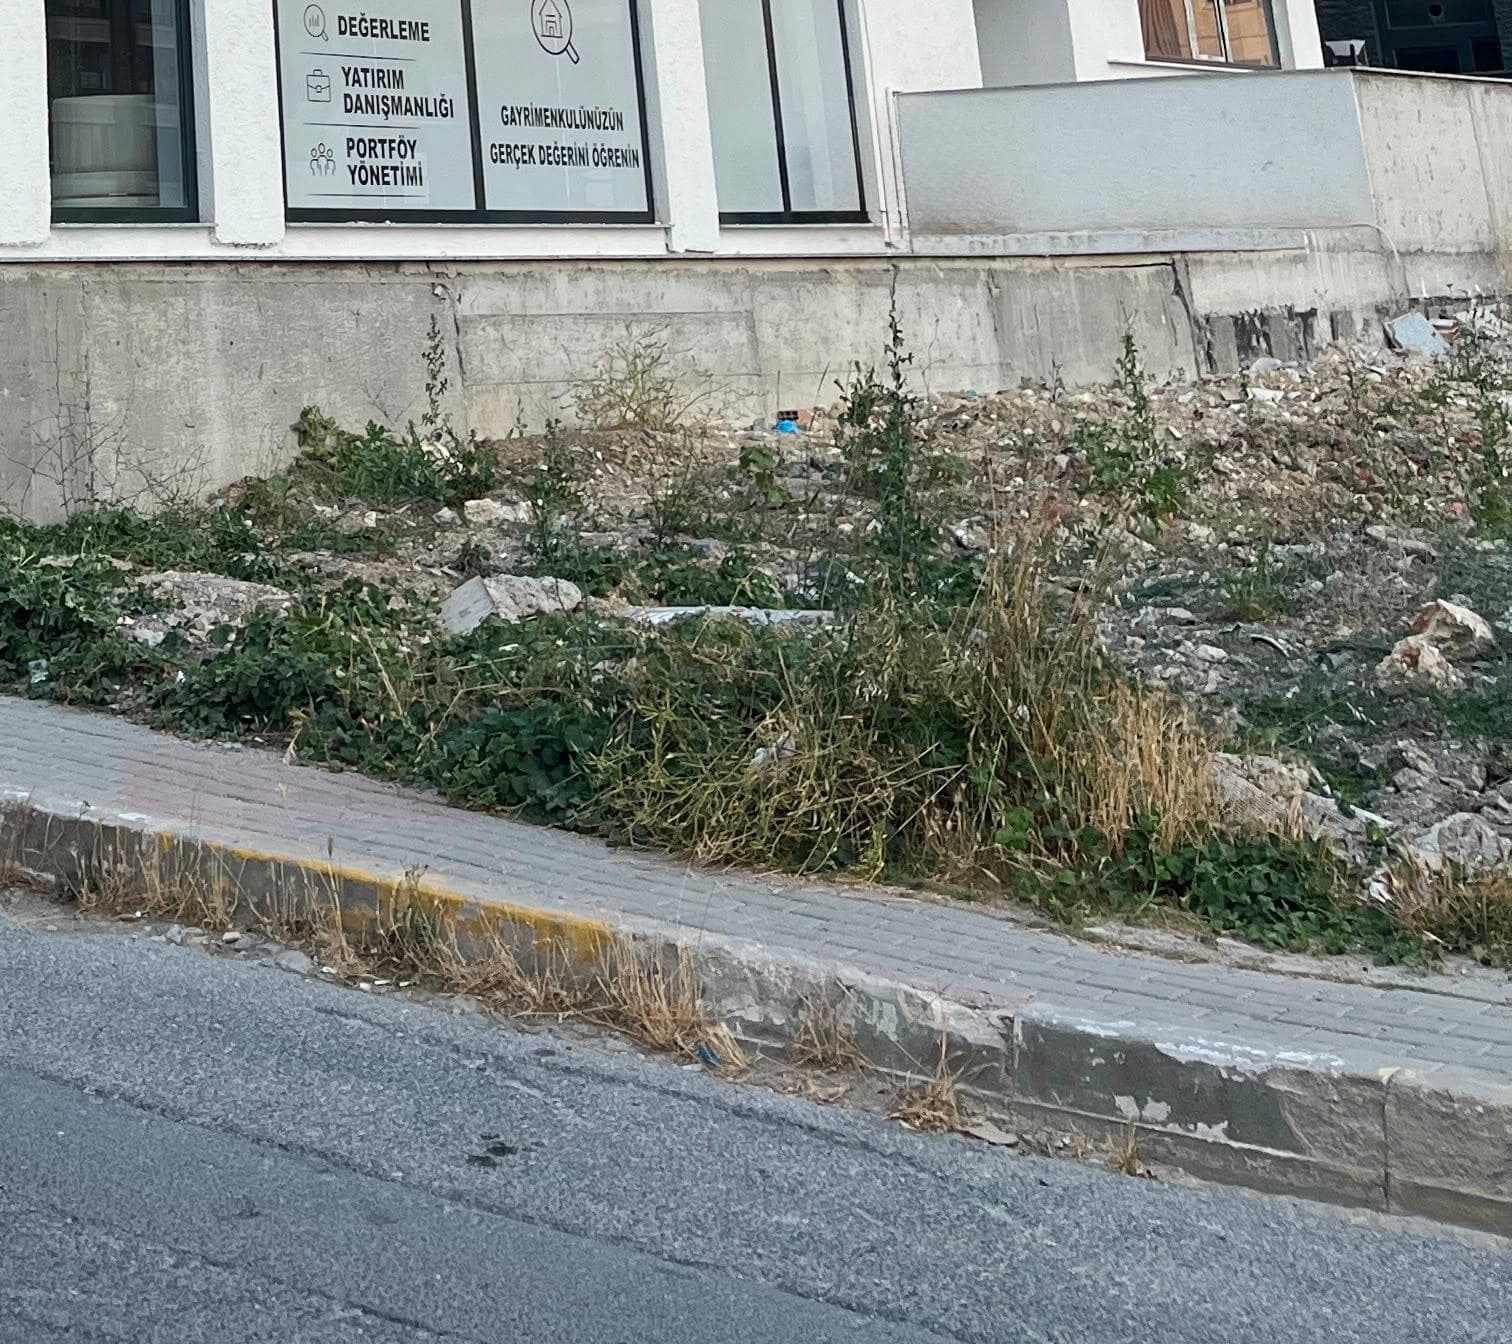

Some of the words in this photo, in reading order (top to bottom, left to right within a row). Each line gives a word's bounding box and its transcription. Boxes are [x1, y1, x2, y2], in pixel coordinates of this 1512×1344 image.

[337, 12, 431, 42] DEĞERLEME
[341, 66, 405, 90] YATIRIM
[343, 92, 455, 121] DANIŞMANLIĞI
[500, 101, 624, 132] GAYRİMENKULÜNÜZÜN
[346, 134, 418, 160] PORTFÖY
[489, 142, 537, 170] GERÇEK
[538, 140, 590, 168] DEĞERİNİ
[592, 142, 640, 169] ÖĞRENİN
[347, 160, 424, 187] YÖNETİMİ
